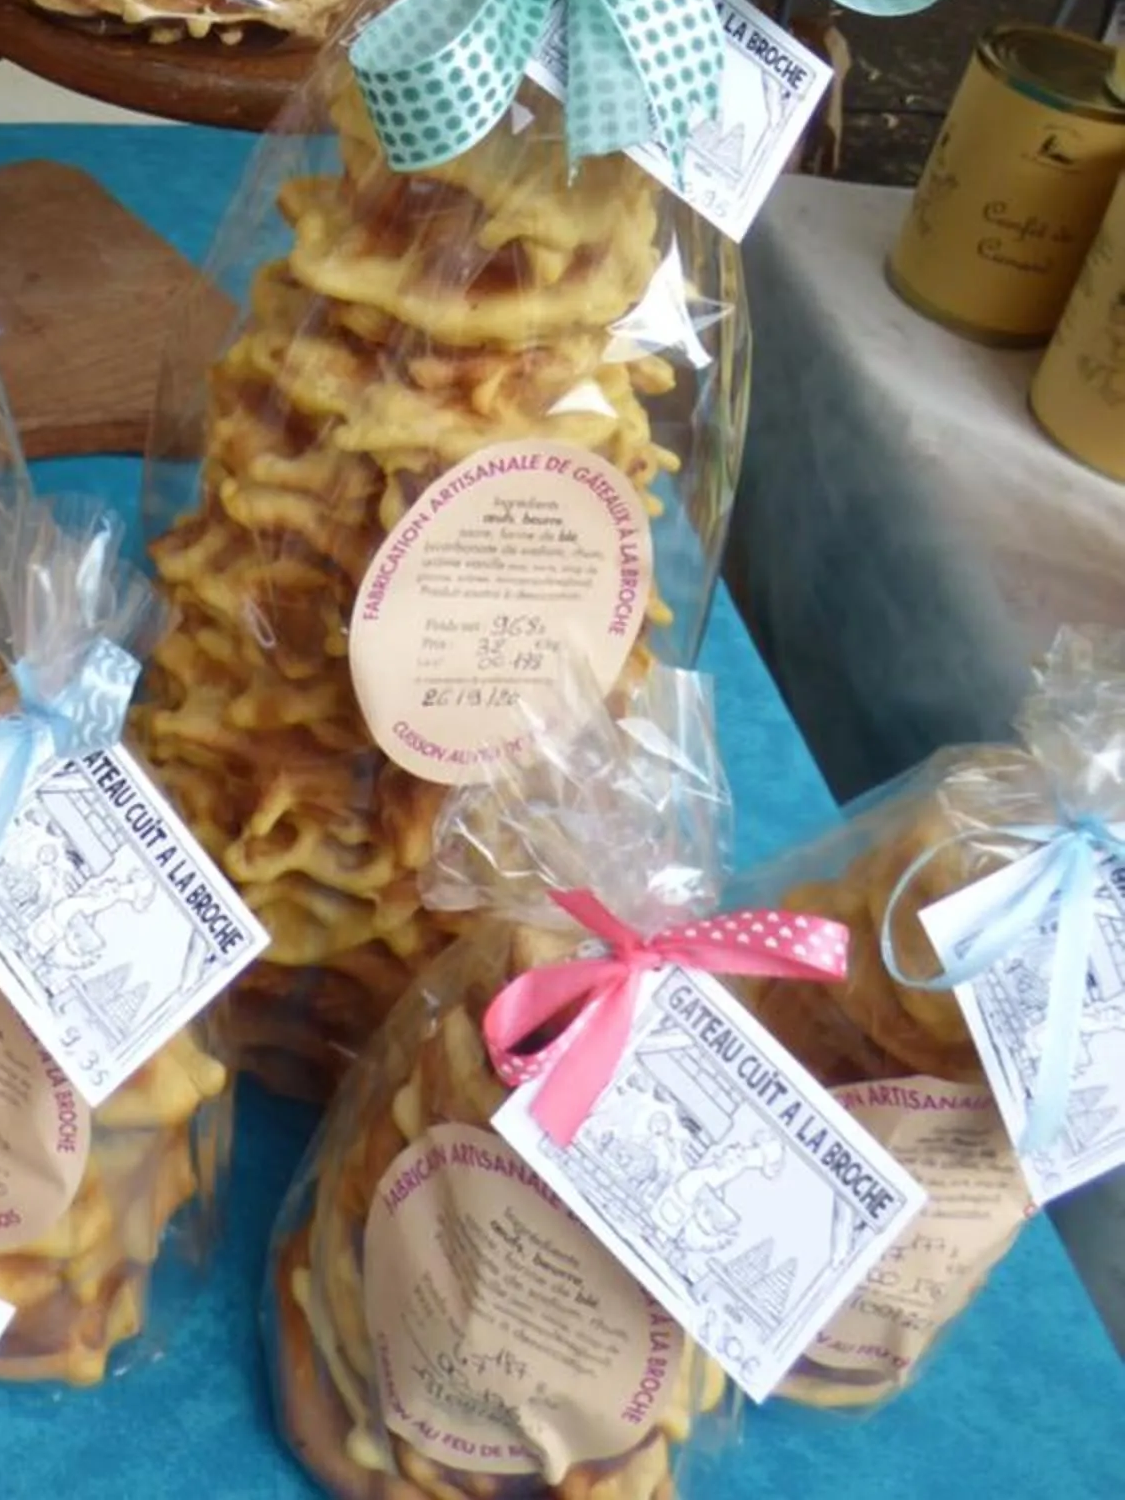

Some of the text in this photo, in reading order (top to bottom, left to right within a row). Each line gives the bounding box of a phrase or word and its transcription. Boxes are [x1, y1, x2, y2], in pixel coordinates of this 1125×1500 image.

[724, 11, 808, 90] LA BROCHE
[429, 454, 541, 518] ARTISANALE
[544, 455, 571, 473] DE
[363, 512, 430, 621] FABRICATION
[619, 543, 638, 566] LA
[608, 569, 639, 637] BROCHE
[392, 720, 447, 763] CUISSON
[83, 750, 137, 808] ATEAU
[156, 847, 178, 868] A
[167, 859, 198, 895] LA
[187, 886, 244, 954] BROCHE
[54, 1082, 79, 1153] BROCHE
[667, 985, 746, 1061] GATEAU
[779, 1101, 799, 1125] A
[795, 1115, 829, 1155] LA
[821, 1141, 894, 1221] BROCHE
[649, 1331, 671, 1355] LA
[621, 1358, 667, 1424] BROCHE
